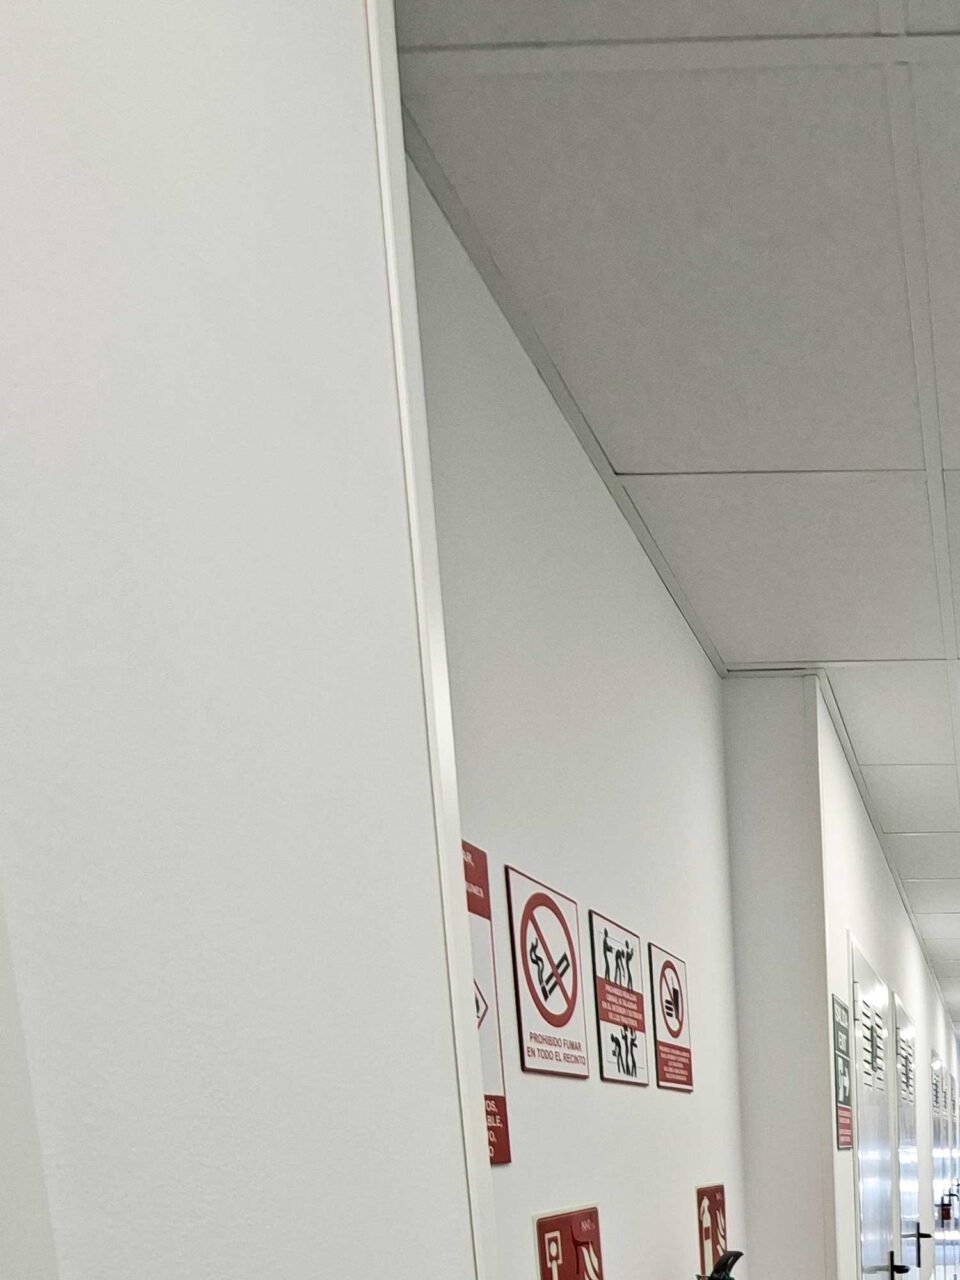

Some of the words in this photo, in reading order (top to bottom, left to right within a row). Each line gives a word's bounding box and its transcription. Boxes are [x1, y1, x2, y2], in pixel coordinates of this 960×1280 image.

[529, 1031, 562, 1048] PROHIBIDO
[563, 1038, 582, 1052] FUMAR
[527, 1046, 536, 1058] EN
[537, 1047, 553, 1061] TODO
[555, 1050, 562, 1062] EL
[563, 1052, 586, 1066] RECINTO
